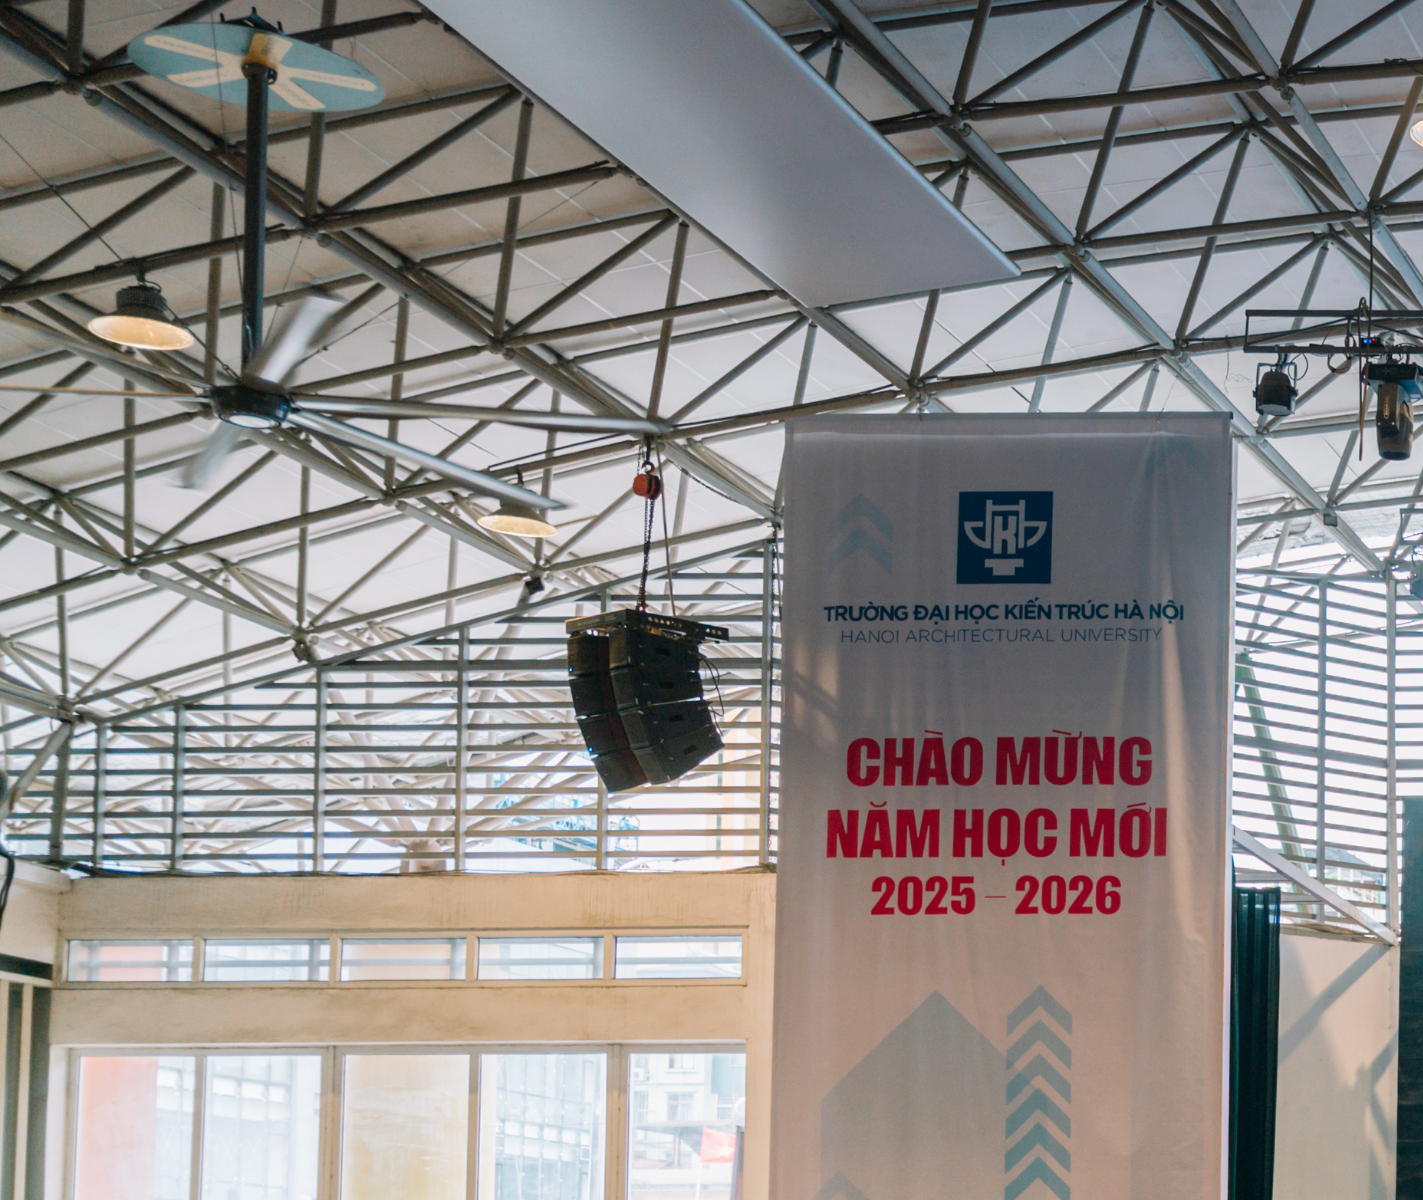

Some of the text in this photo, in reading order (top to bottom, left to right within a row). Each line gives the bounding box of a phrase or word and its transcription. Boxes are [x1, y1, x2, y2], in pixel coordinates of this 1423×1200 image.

[824, 597, 1184, 625] TRƯỜNG ĐẠI HỌC KIẾN TRÚC HÀ NỘI
[840, 627, 1162, 644] HANOI ARCHITECTURAL UNIVERSITY
[846, 729, 1153, 787] CHÀO MỪNG
[826, 801, 1168, 866] NĂM HỌC MỚI
[870, 875, 976, 916] 2025
[1014, 874, 1122, 915] 2026
